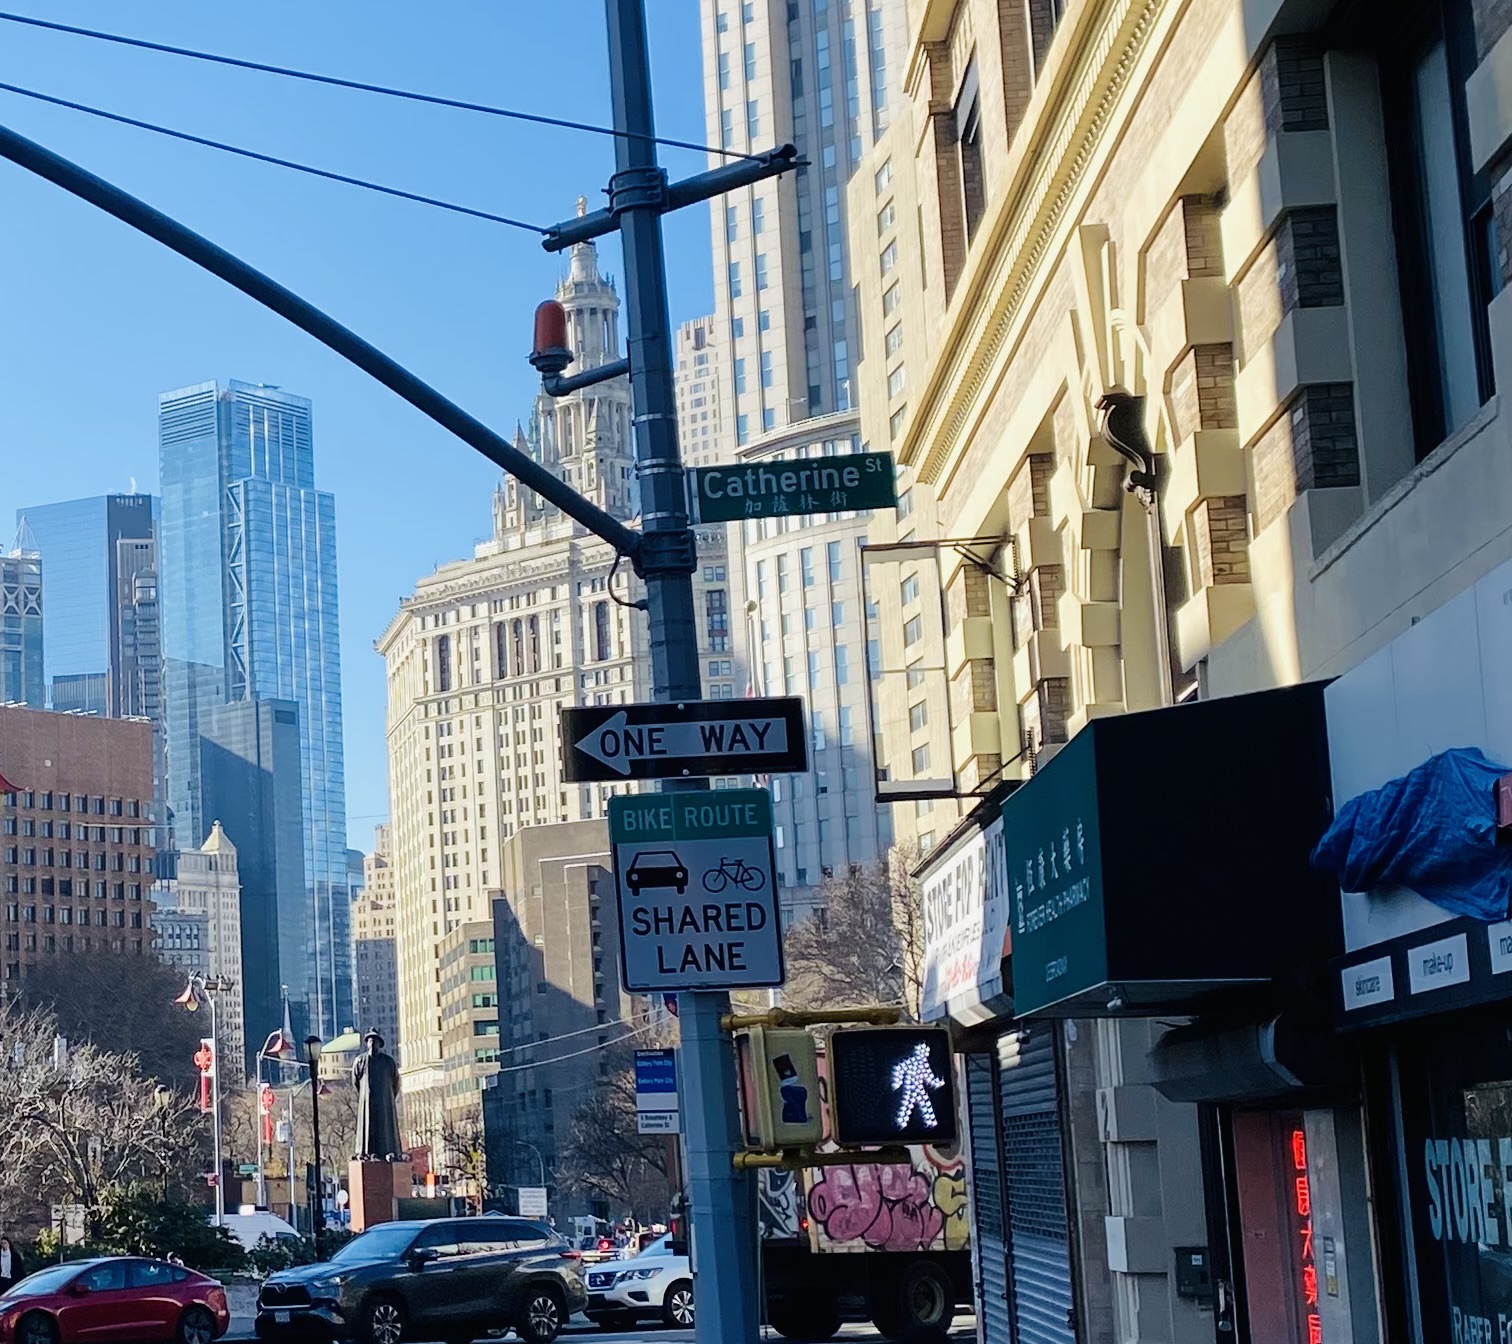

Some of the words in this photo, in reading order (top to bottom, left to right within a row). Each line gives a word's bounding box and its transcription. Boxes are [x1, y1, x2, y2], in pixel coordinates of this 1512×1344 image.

[703, 462, 860, 500] Catherine
[865, 457, 883, 474] St
[599, 726, 668, 758] ONE
[700, 721, 772, 753] WAY
[623, 807, 673, 832] BIKE
[685, 803, 759, 828] ROUTE
[632, 902, 767, 937] SHARED
[656, 941, 747, 974] LANE
[1422, 951, 1454, 976] make-up
[1355, 974, 1381, 997] skincare
[1425, 1137, 1499, 1244] STORE
